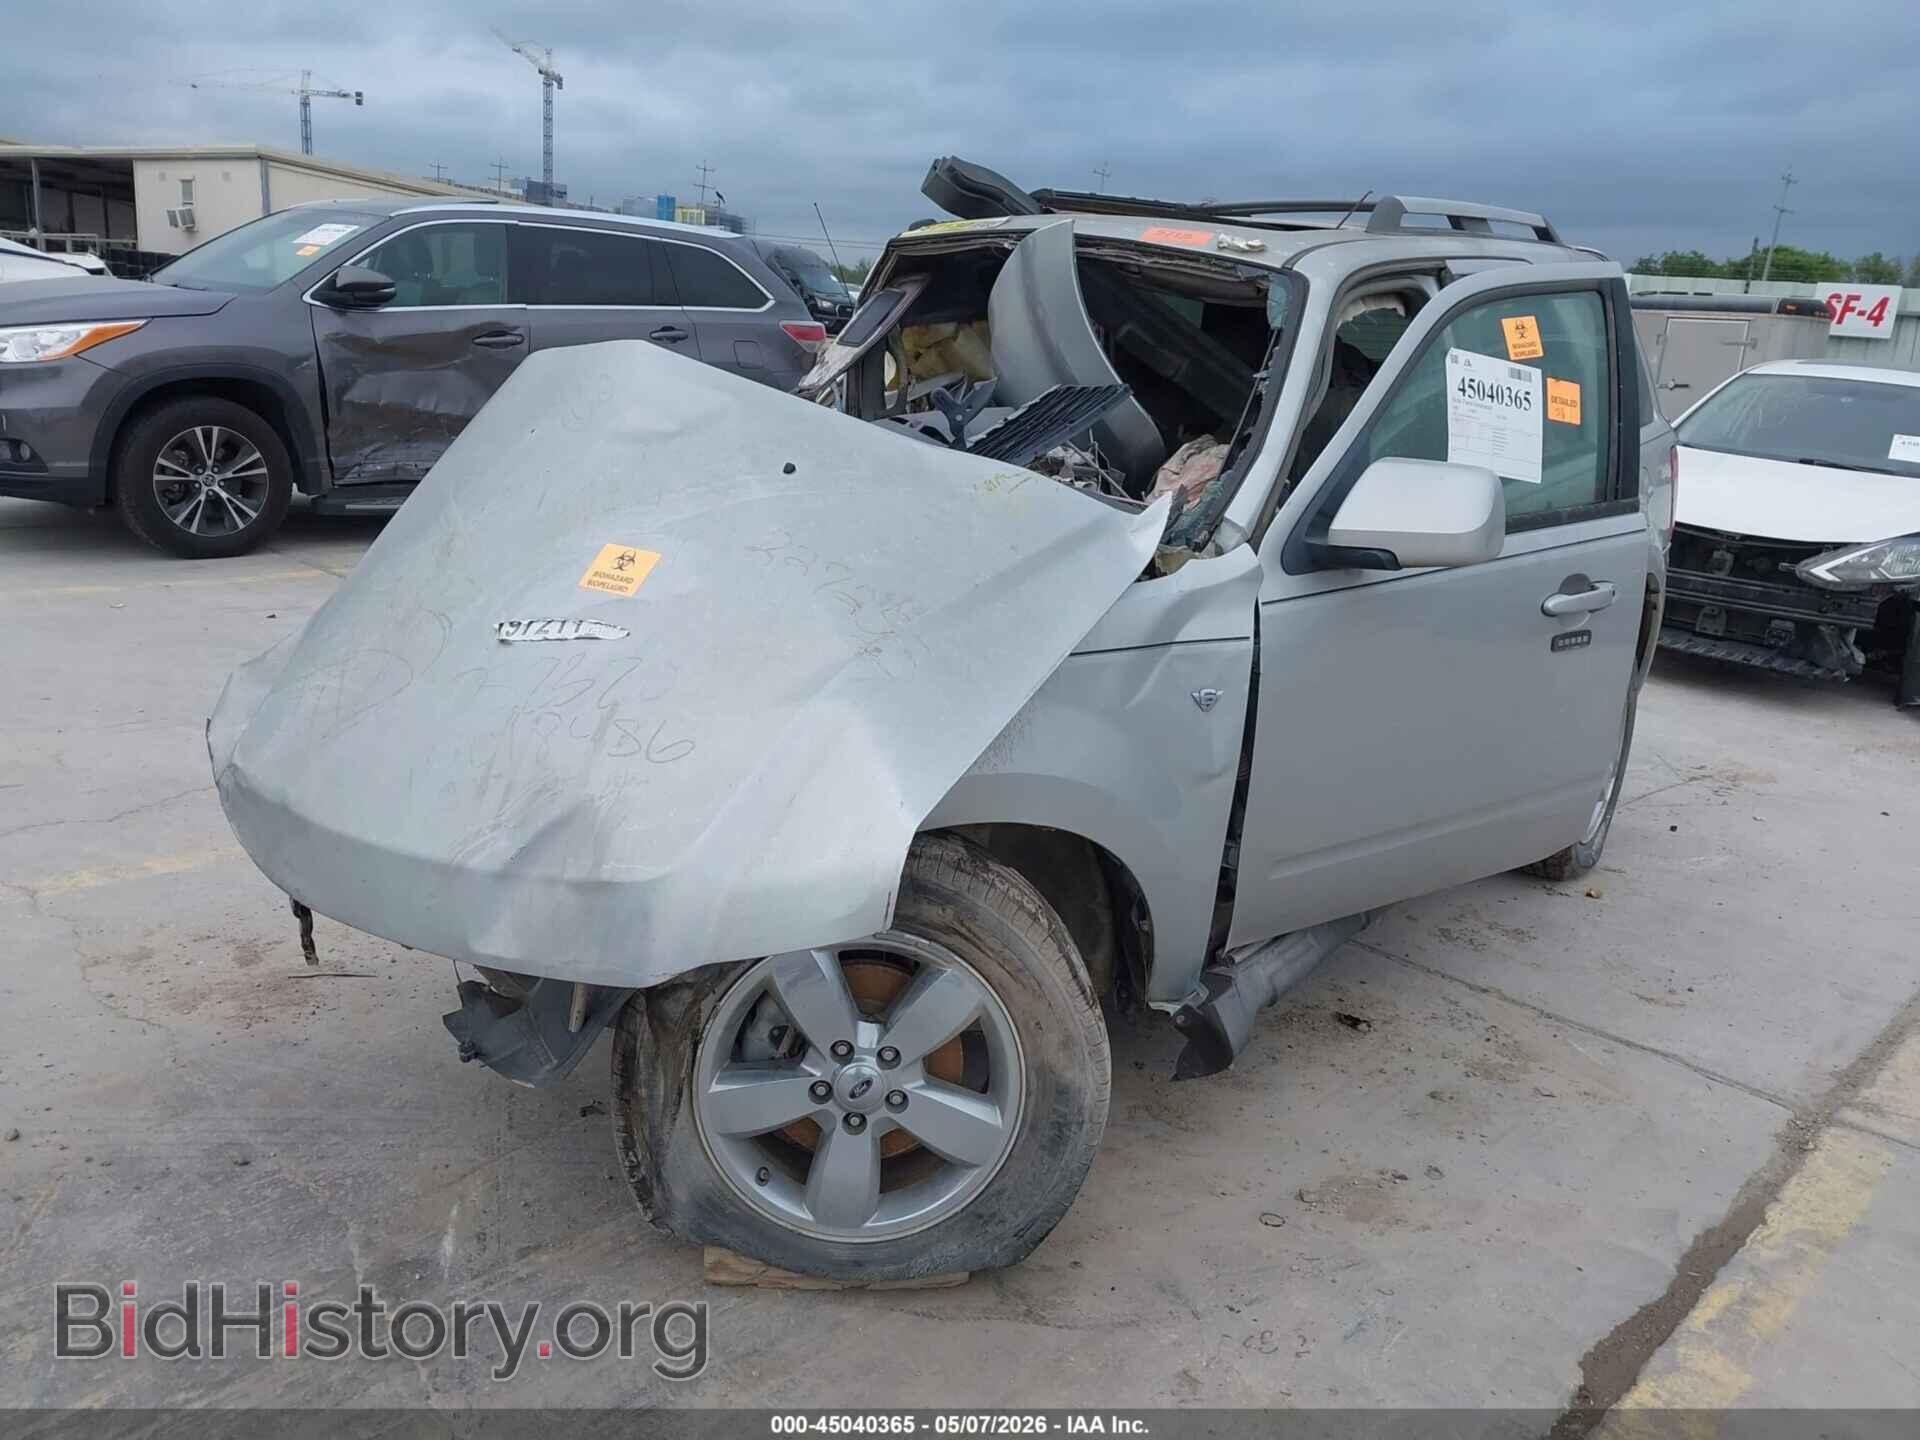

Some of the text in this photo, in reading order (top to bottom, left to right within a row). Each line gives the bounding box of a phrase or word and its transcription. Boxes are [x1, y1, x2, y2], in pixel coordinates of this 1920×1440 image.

[1824, 292, 1890, 328] SF-4
[1457, 376, 1532, 411] 45040365
[592, 570, 634, 584] BIOHAZARD
